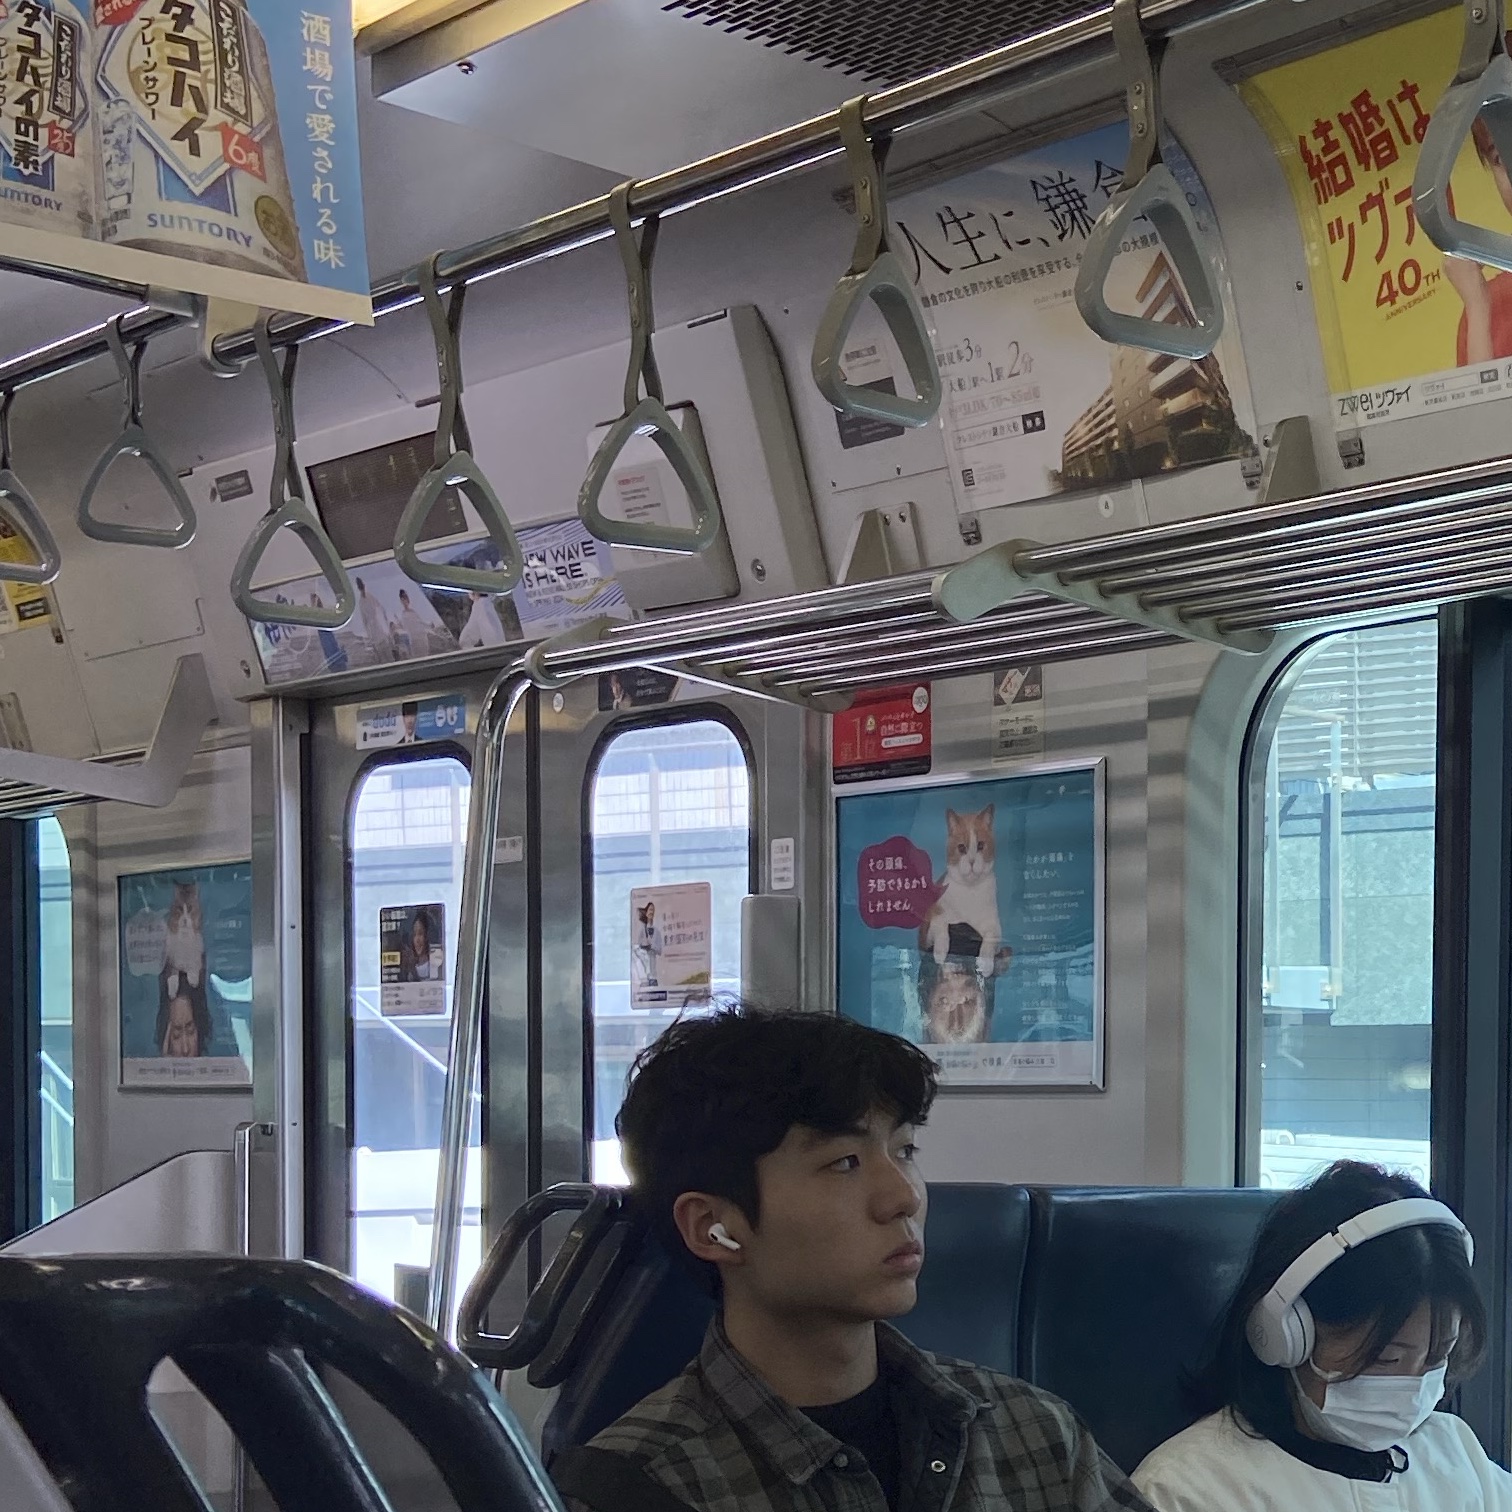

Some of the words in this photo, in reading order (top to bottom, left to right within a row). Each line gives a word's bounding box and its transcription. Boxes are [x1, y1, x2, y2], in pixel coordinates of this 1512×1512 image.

[139, 17, 159, 120] プレーンサワー
[159, 0, 210, 158] タコハイ
[300, 10, 345, 270] 酒場で愛される味
[1299, 79, 1431, 205] 結婚は
[0, 187, 63, 212] UNTORY
[147, 212, 253, 247] SUNTORY
[1328, 177, 1455, 284] ツヴァ
[1384, 289, 1437, 321] ANNIVERSARY
[1375, 385, 1412, 408] ツヴァイ
[550, 540, 597, 563] WAVE
[522, 572, 534, 589] IS
[867, 875, 928, 893] 予防できるかも
[868, 898, 915, 914] しれません。
